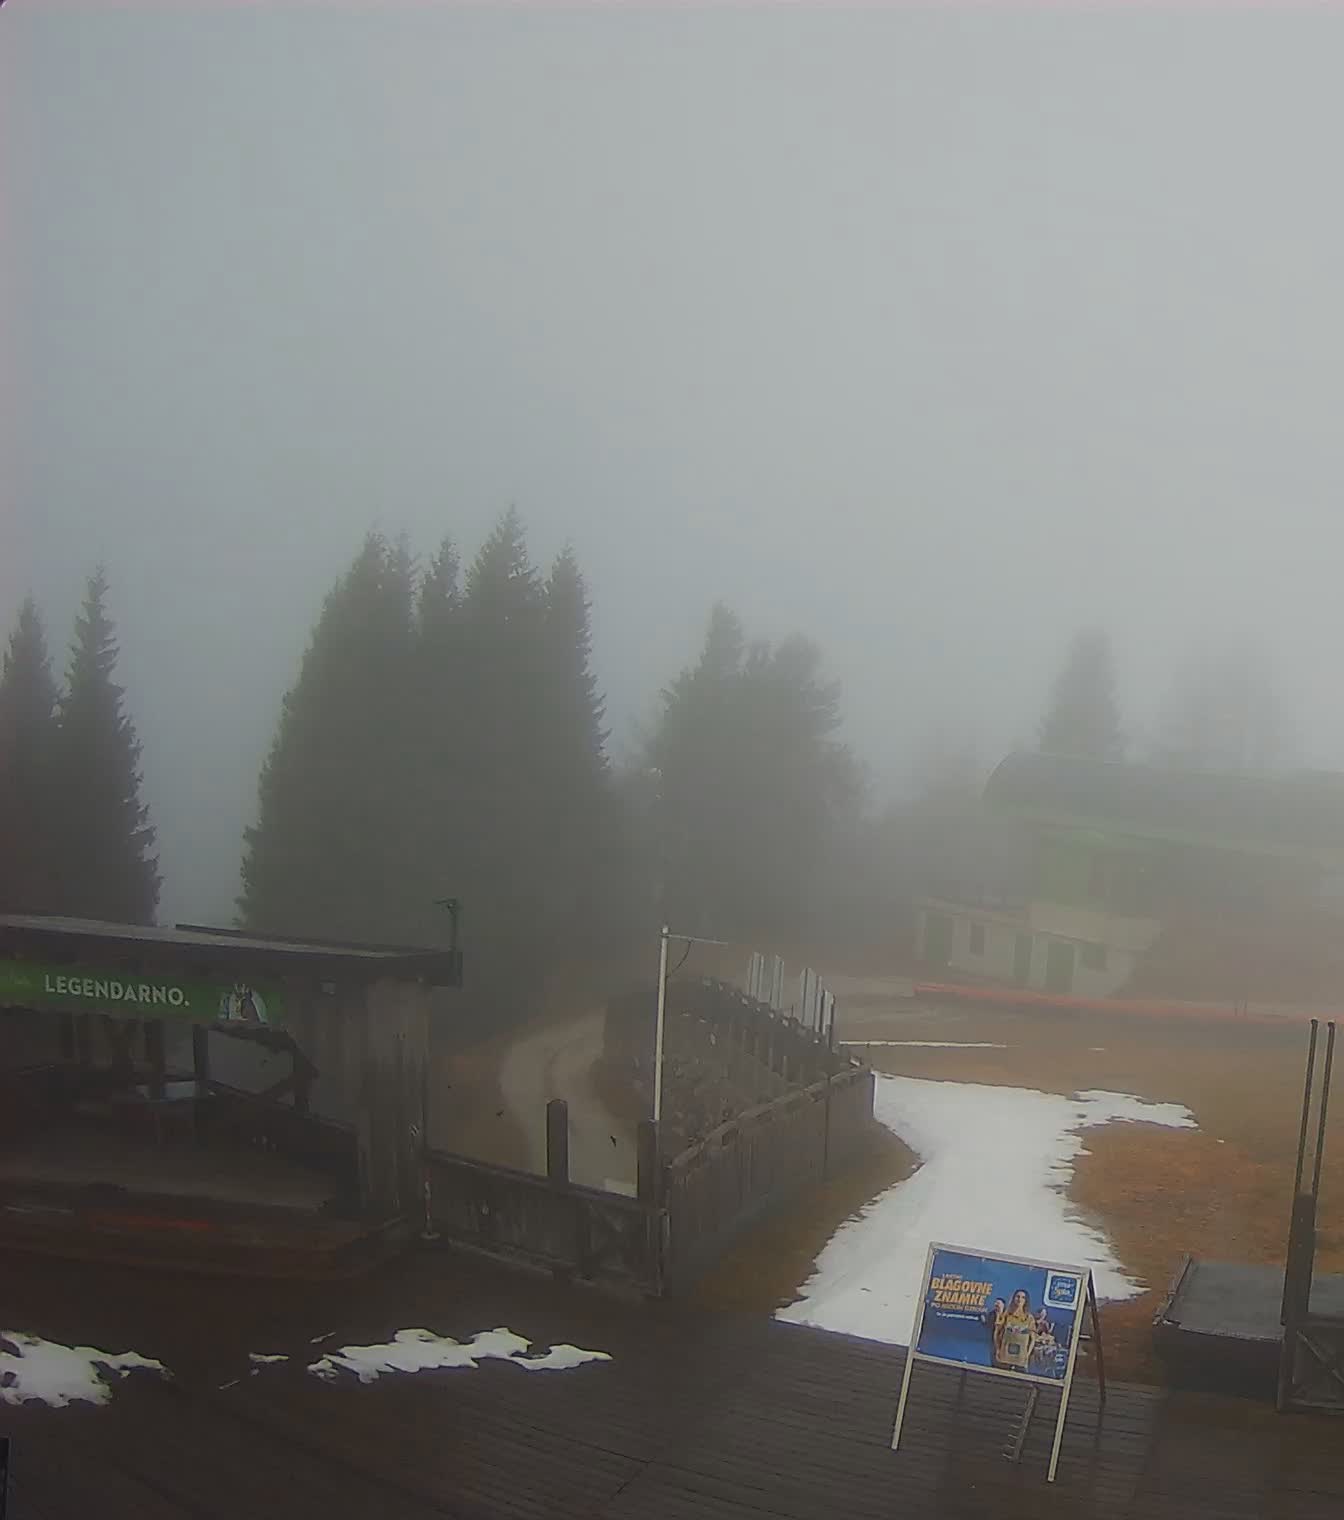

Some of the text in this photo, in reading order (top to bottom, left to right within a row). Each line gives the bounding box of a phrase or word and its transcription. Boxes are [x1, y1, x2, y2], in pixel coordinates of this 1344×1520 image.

[44, 974, 190, 1007] LEGENDARNO.
[931, 1277, 993, 1296] BLAGOVNE
[934, 1290, 987, 1306] ZNAMKE
